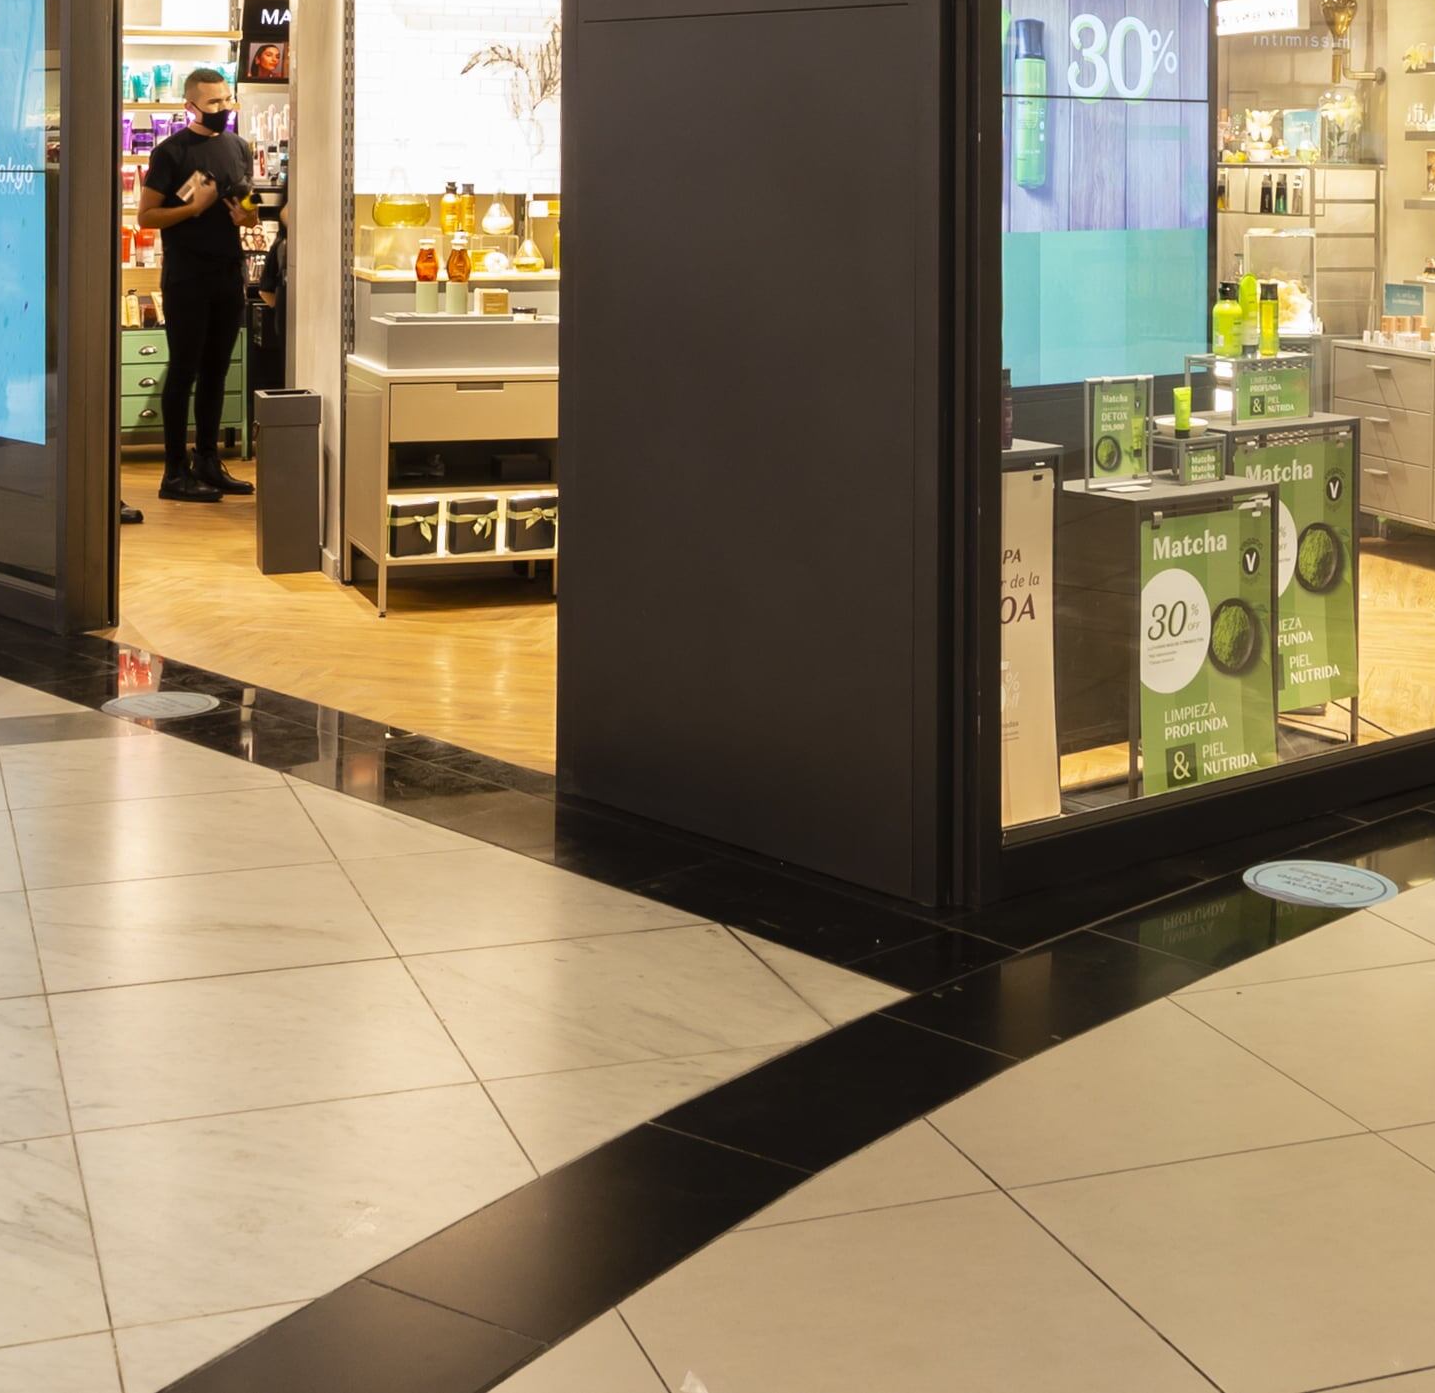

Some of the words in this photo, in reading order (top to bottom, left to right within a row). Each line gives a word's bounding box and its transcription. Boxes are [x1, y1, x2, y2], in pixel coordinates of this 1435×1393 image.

[1067, 12, 1178, 104] 30%
[1101, 392, 1129, 404] Matcha
[1252, 397, 1262, 413] &
[1101, 412, 1128, 422] DETOX
[1191, 454, 1216, 464] Matcha
[1191, 463, 1216, 474] Matcha
[1245, 458, 1314, 483] Matcha
[1152, 529, 1228, 561] Matcha
[1010, 572, 1025, 589] de
[1028, 571, 1040, 587] la
[1187, 621, 1201, 632] OFF
[1277, 629, 1314, 649] FUNDA
[1289, 654, 1312, 669] PIEL
[1290, 663, 1341, 685] NUTRIDA
[1164, 701, 1217, 724] LIMPIEZA
[1164, 715, 1229, 741] PROFUNDA
[1202, 741, 1228, 759] PIEL
[1172, 750, 1192, 780] &
[1203, 751, 1259, 777] NUTRIDA
